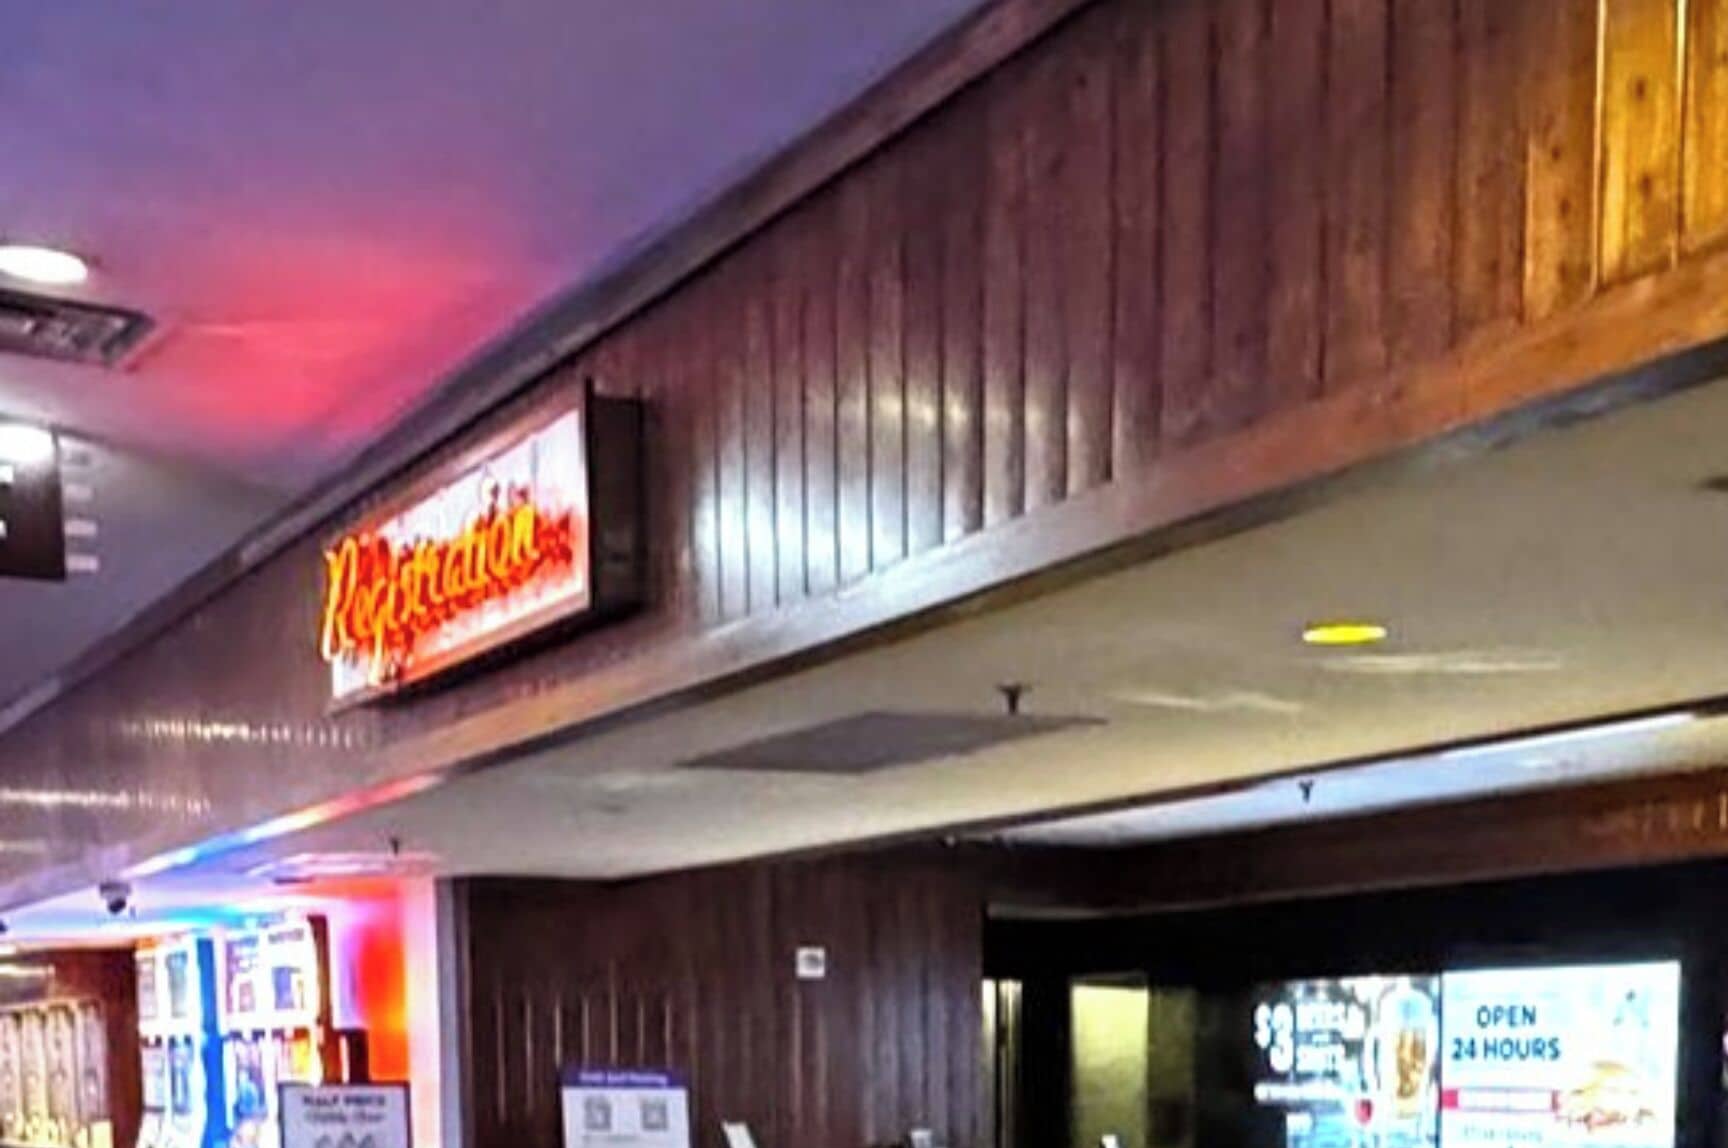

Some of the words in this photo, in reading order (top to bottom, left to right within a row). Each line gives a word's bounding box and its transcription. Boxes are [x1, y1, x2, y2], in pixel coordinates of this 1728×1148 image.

[321, 496, 541, 687] Registration
[1476, 1004, 1537, 1029] OPEN
[1452, 1036, 1477, 1061] 24
[1482, 1036, 1561, 1062] HOURS
